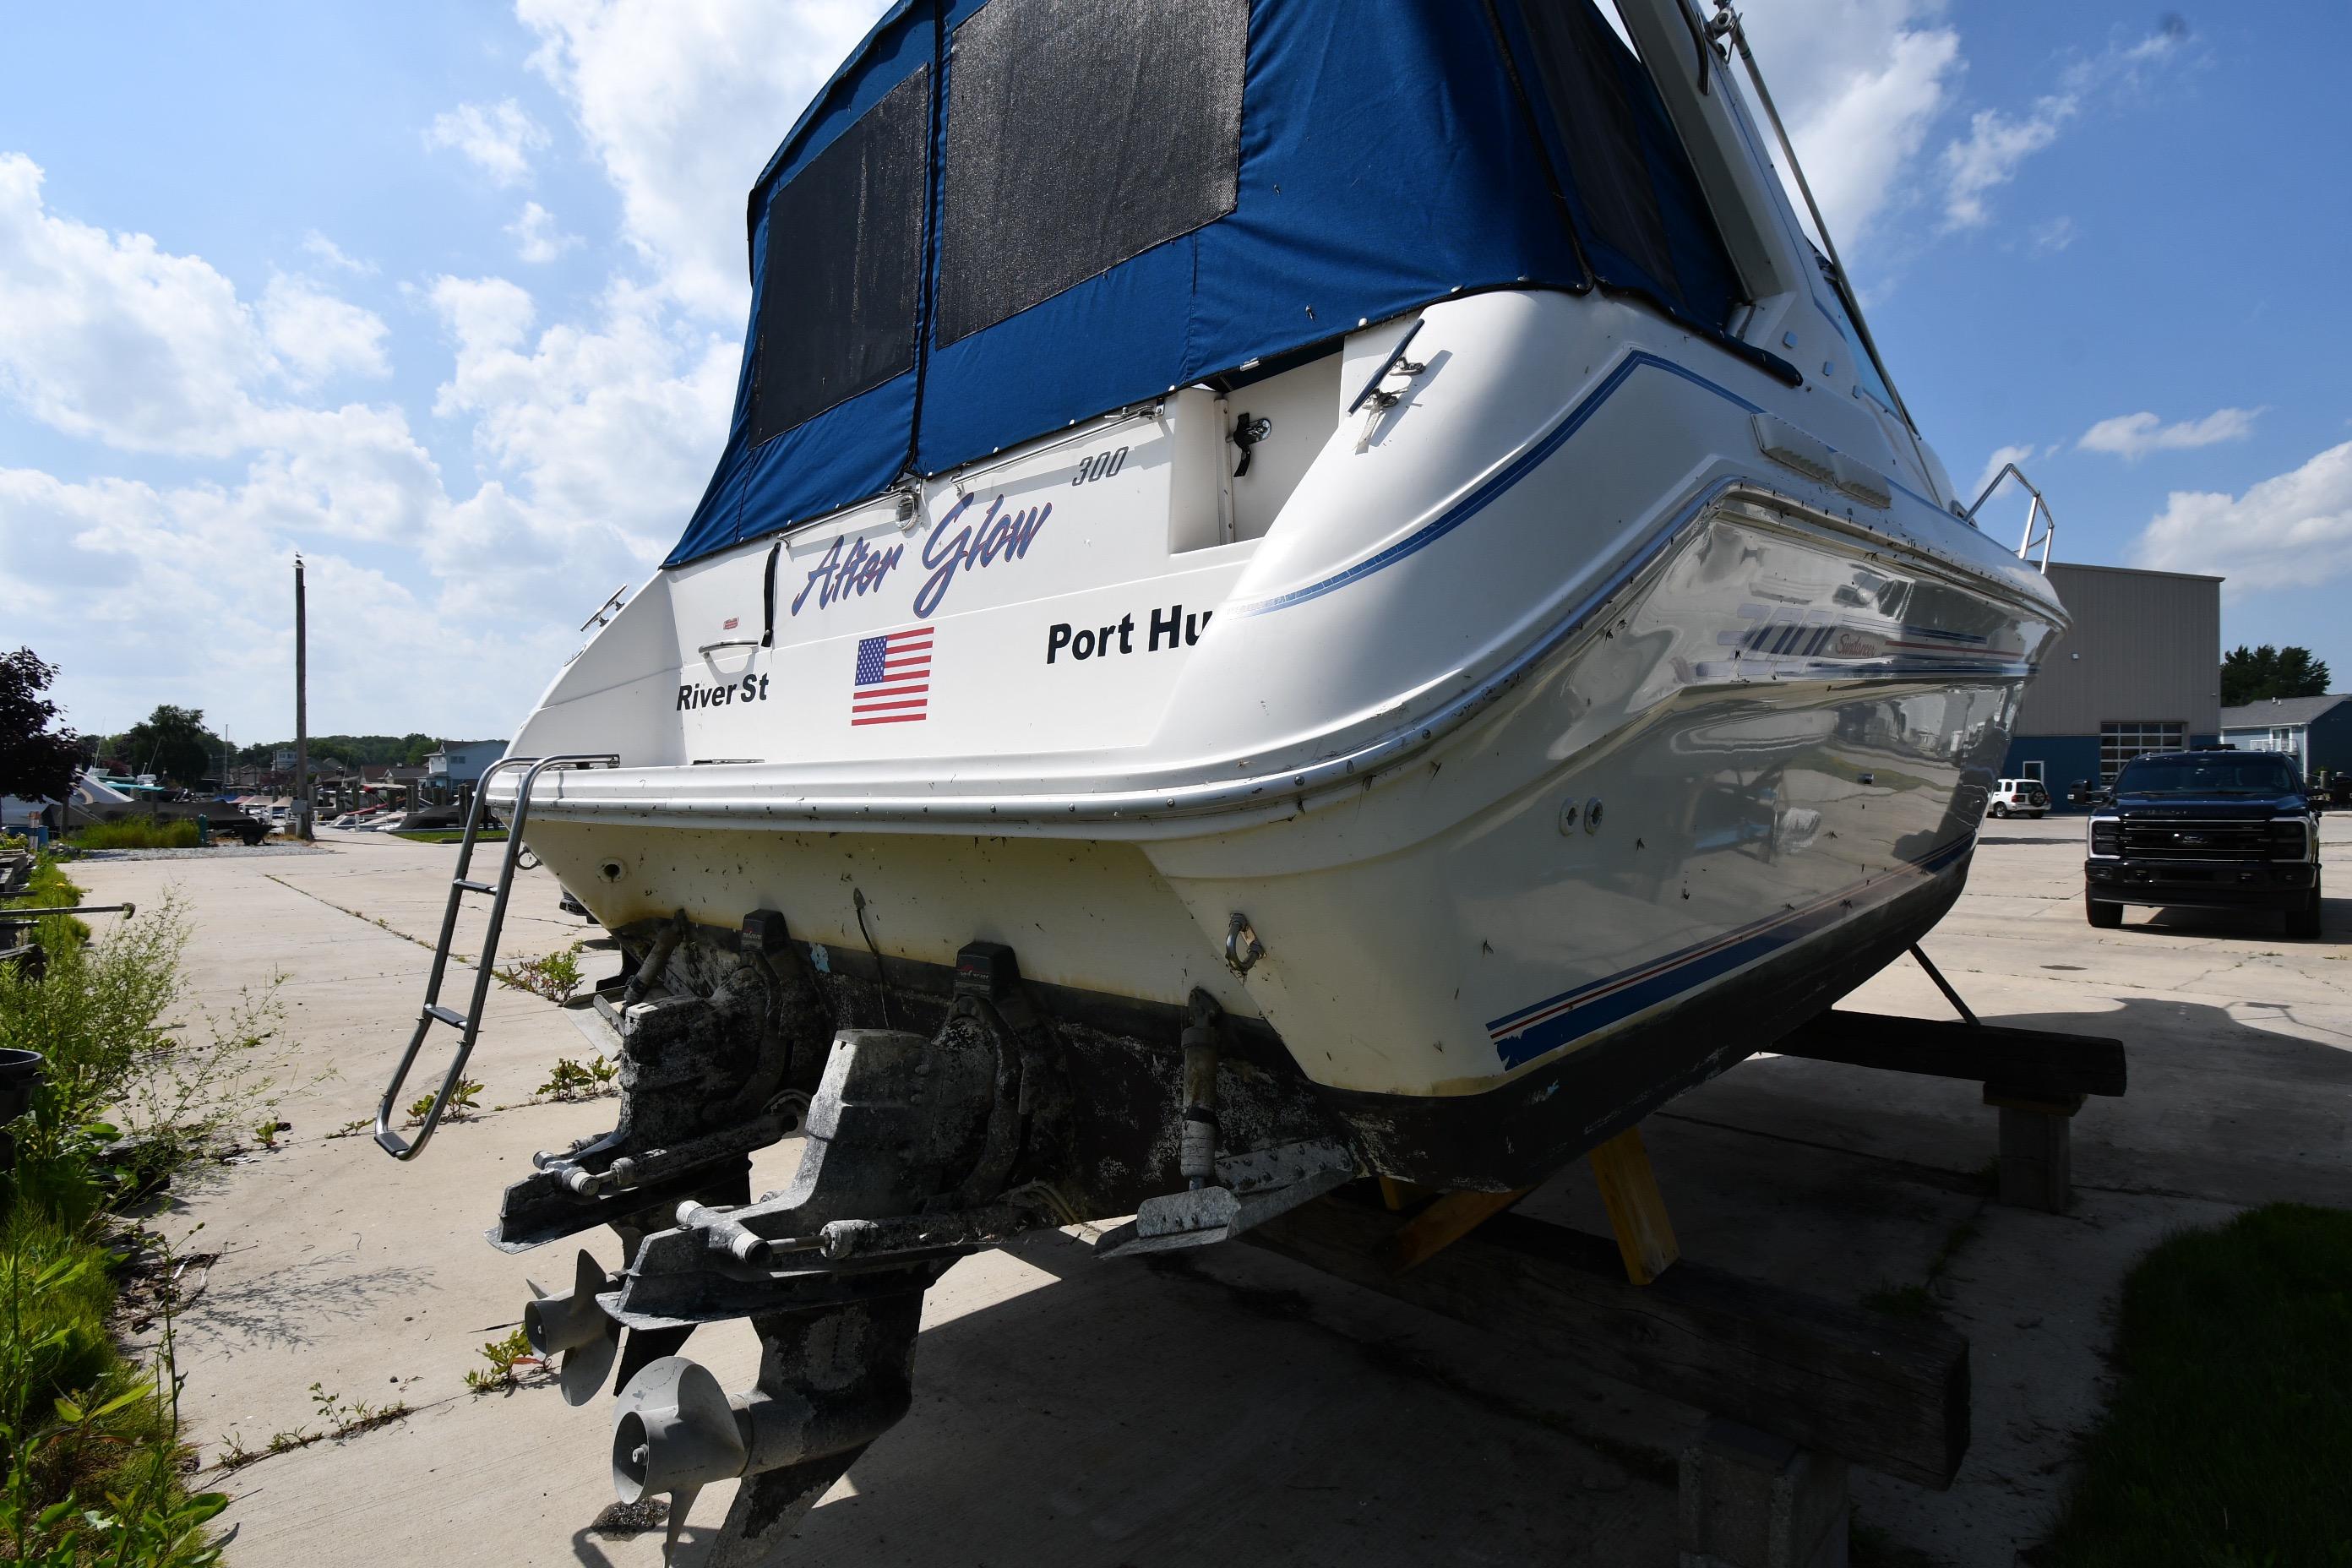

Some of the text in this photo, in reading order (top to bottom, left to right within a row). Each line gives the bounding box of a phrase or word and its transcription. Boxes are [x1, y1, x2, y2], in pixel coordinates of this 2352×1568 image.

[1072, 446, 1129, 487] 300
[791, 492, 1053, 619] After Glow
[1047, 596, 1135, 664] Port
[677, 672, 770, 710] River St
